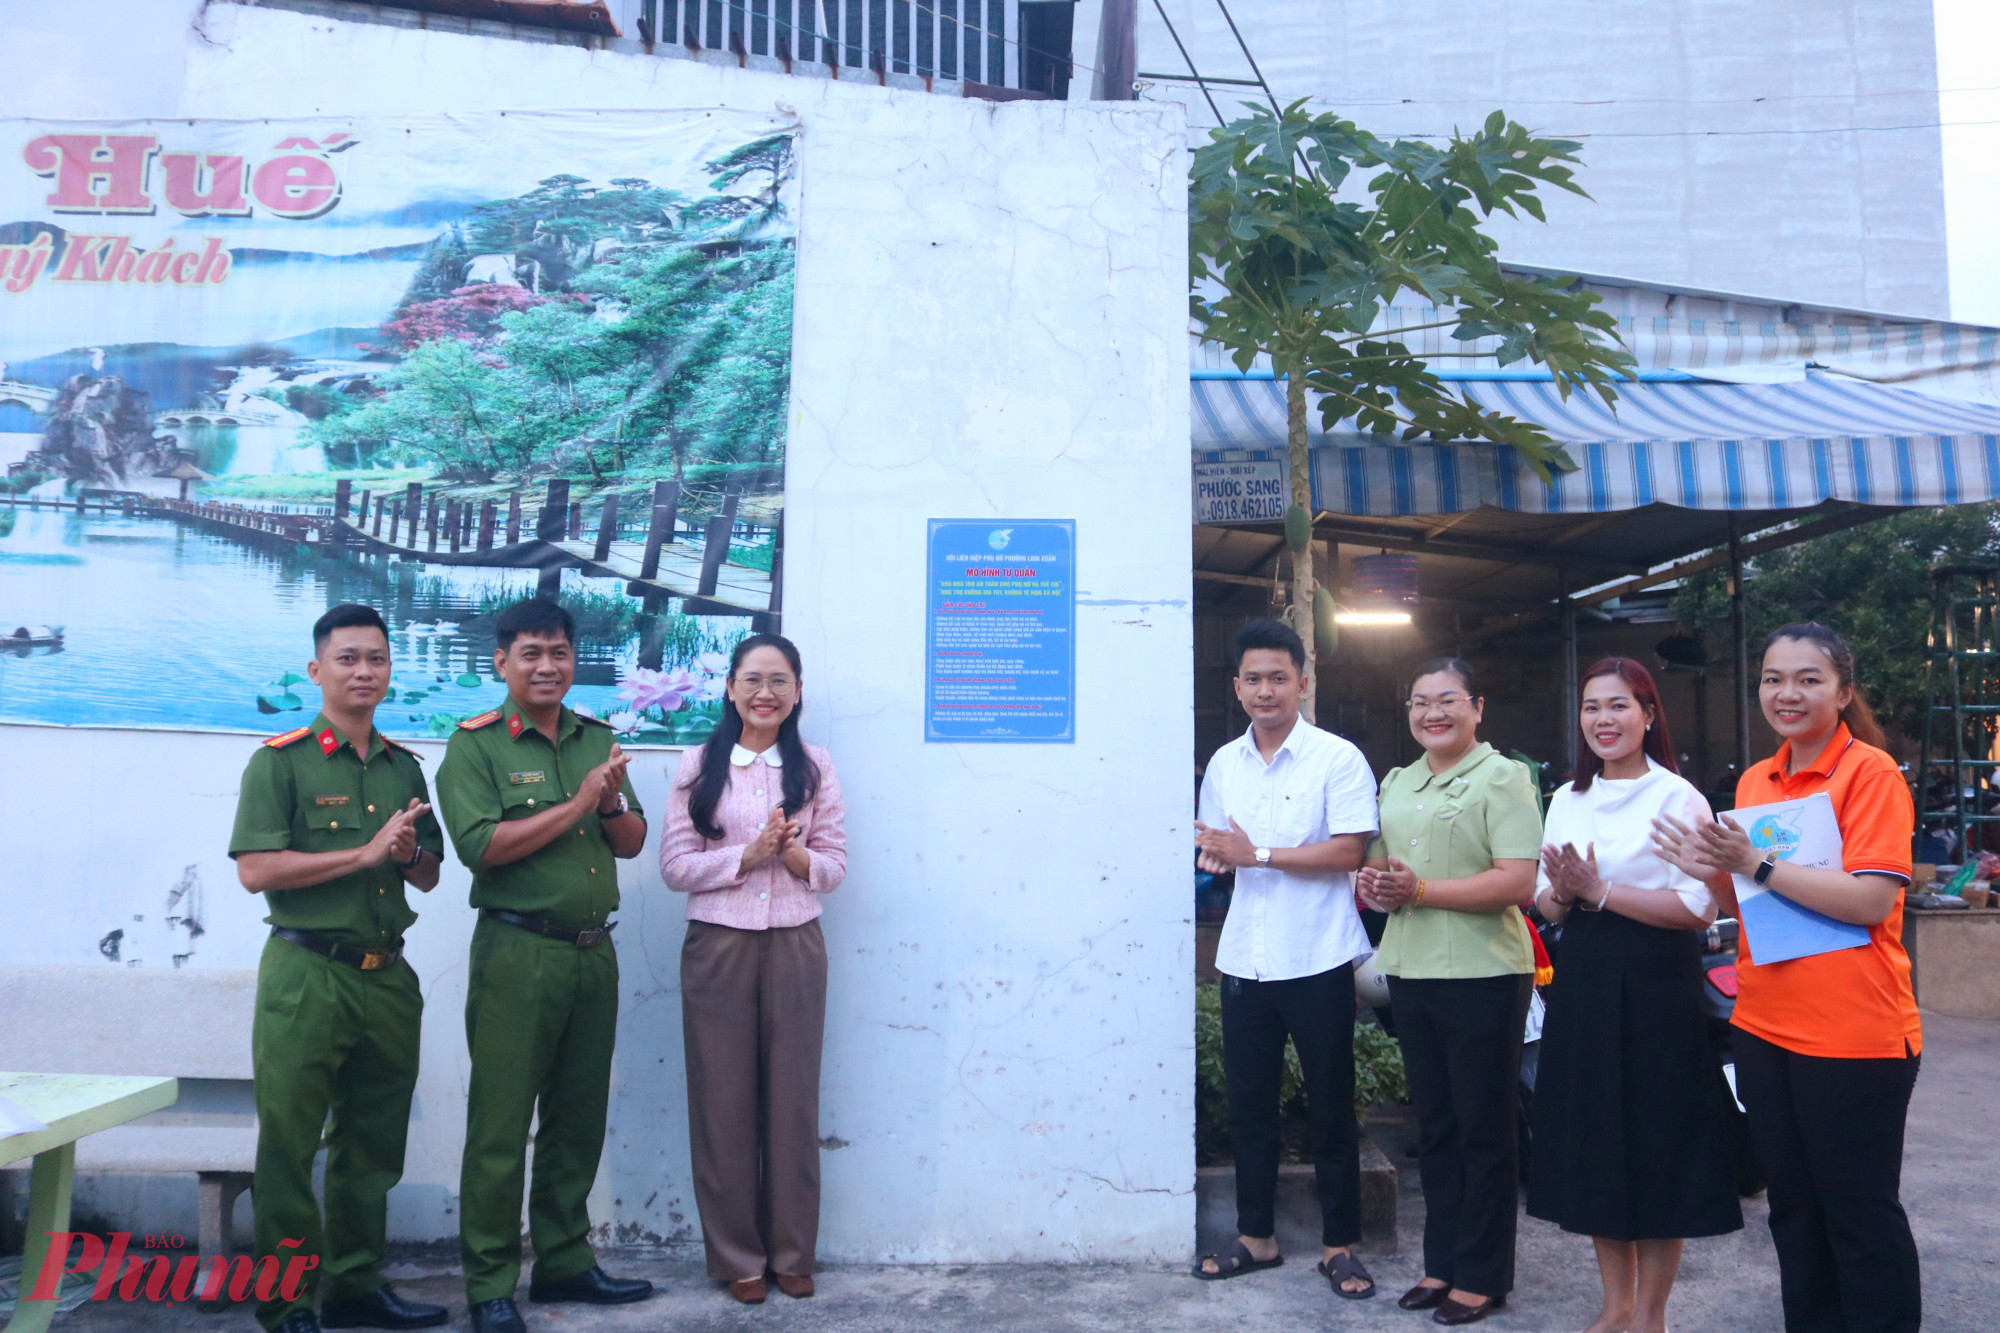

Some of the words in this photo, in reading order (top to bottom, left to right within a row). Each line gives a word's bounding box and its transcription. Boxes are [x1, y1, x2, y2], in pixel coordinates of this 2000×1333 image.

[22, 132, 357, 216] Huế
[52, 233, 232, 286] Khách
[1198, 477, 1242, 498] PHƯỚC
[1246, 479, 1280, 496] SANG
[966, 567, 979, 577] MÔ
[981, 567, 1000, 577] HÌNH
[1003, 568, 1012, 578] TỰ
[1014, 566, 1036, 577] QUẢN
